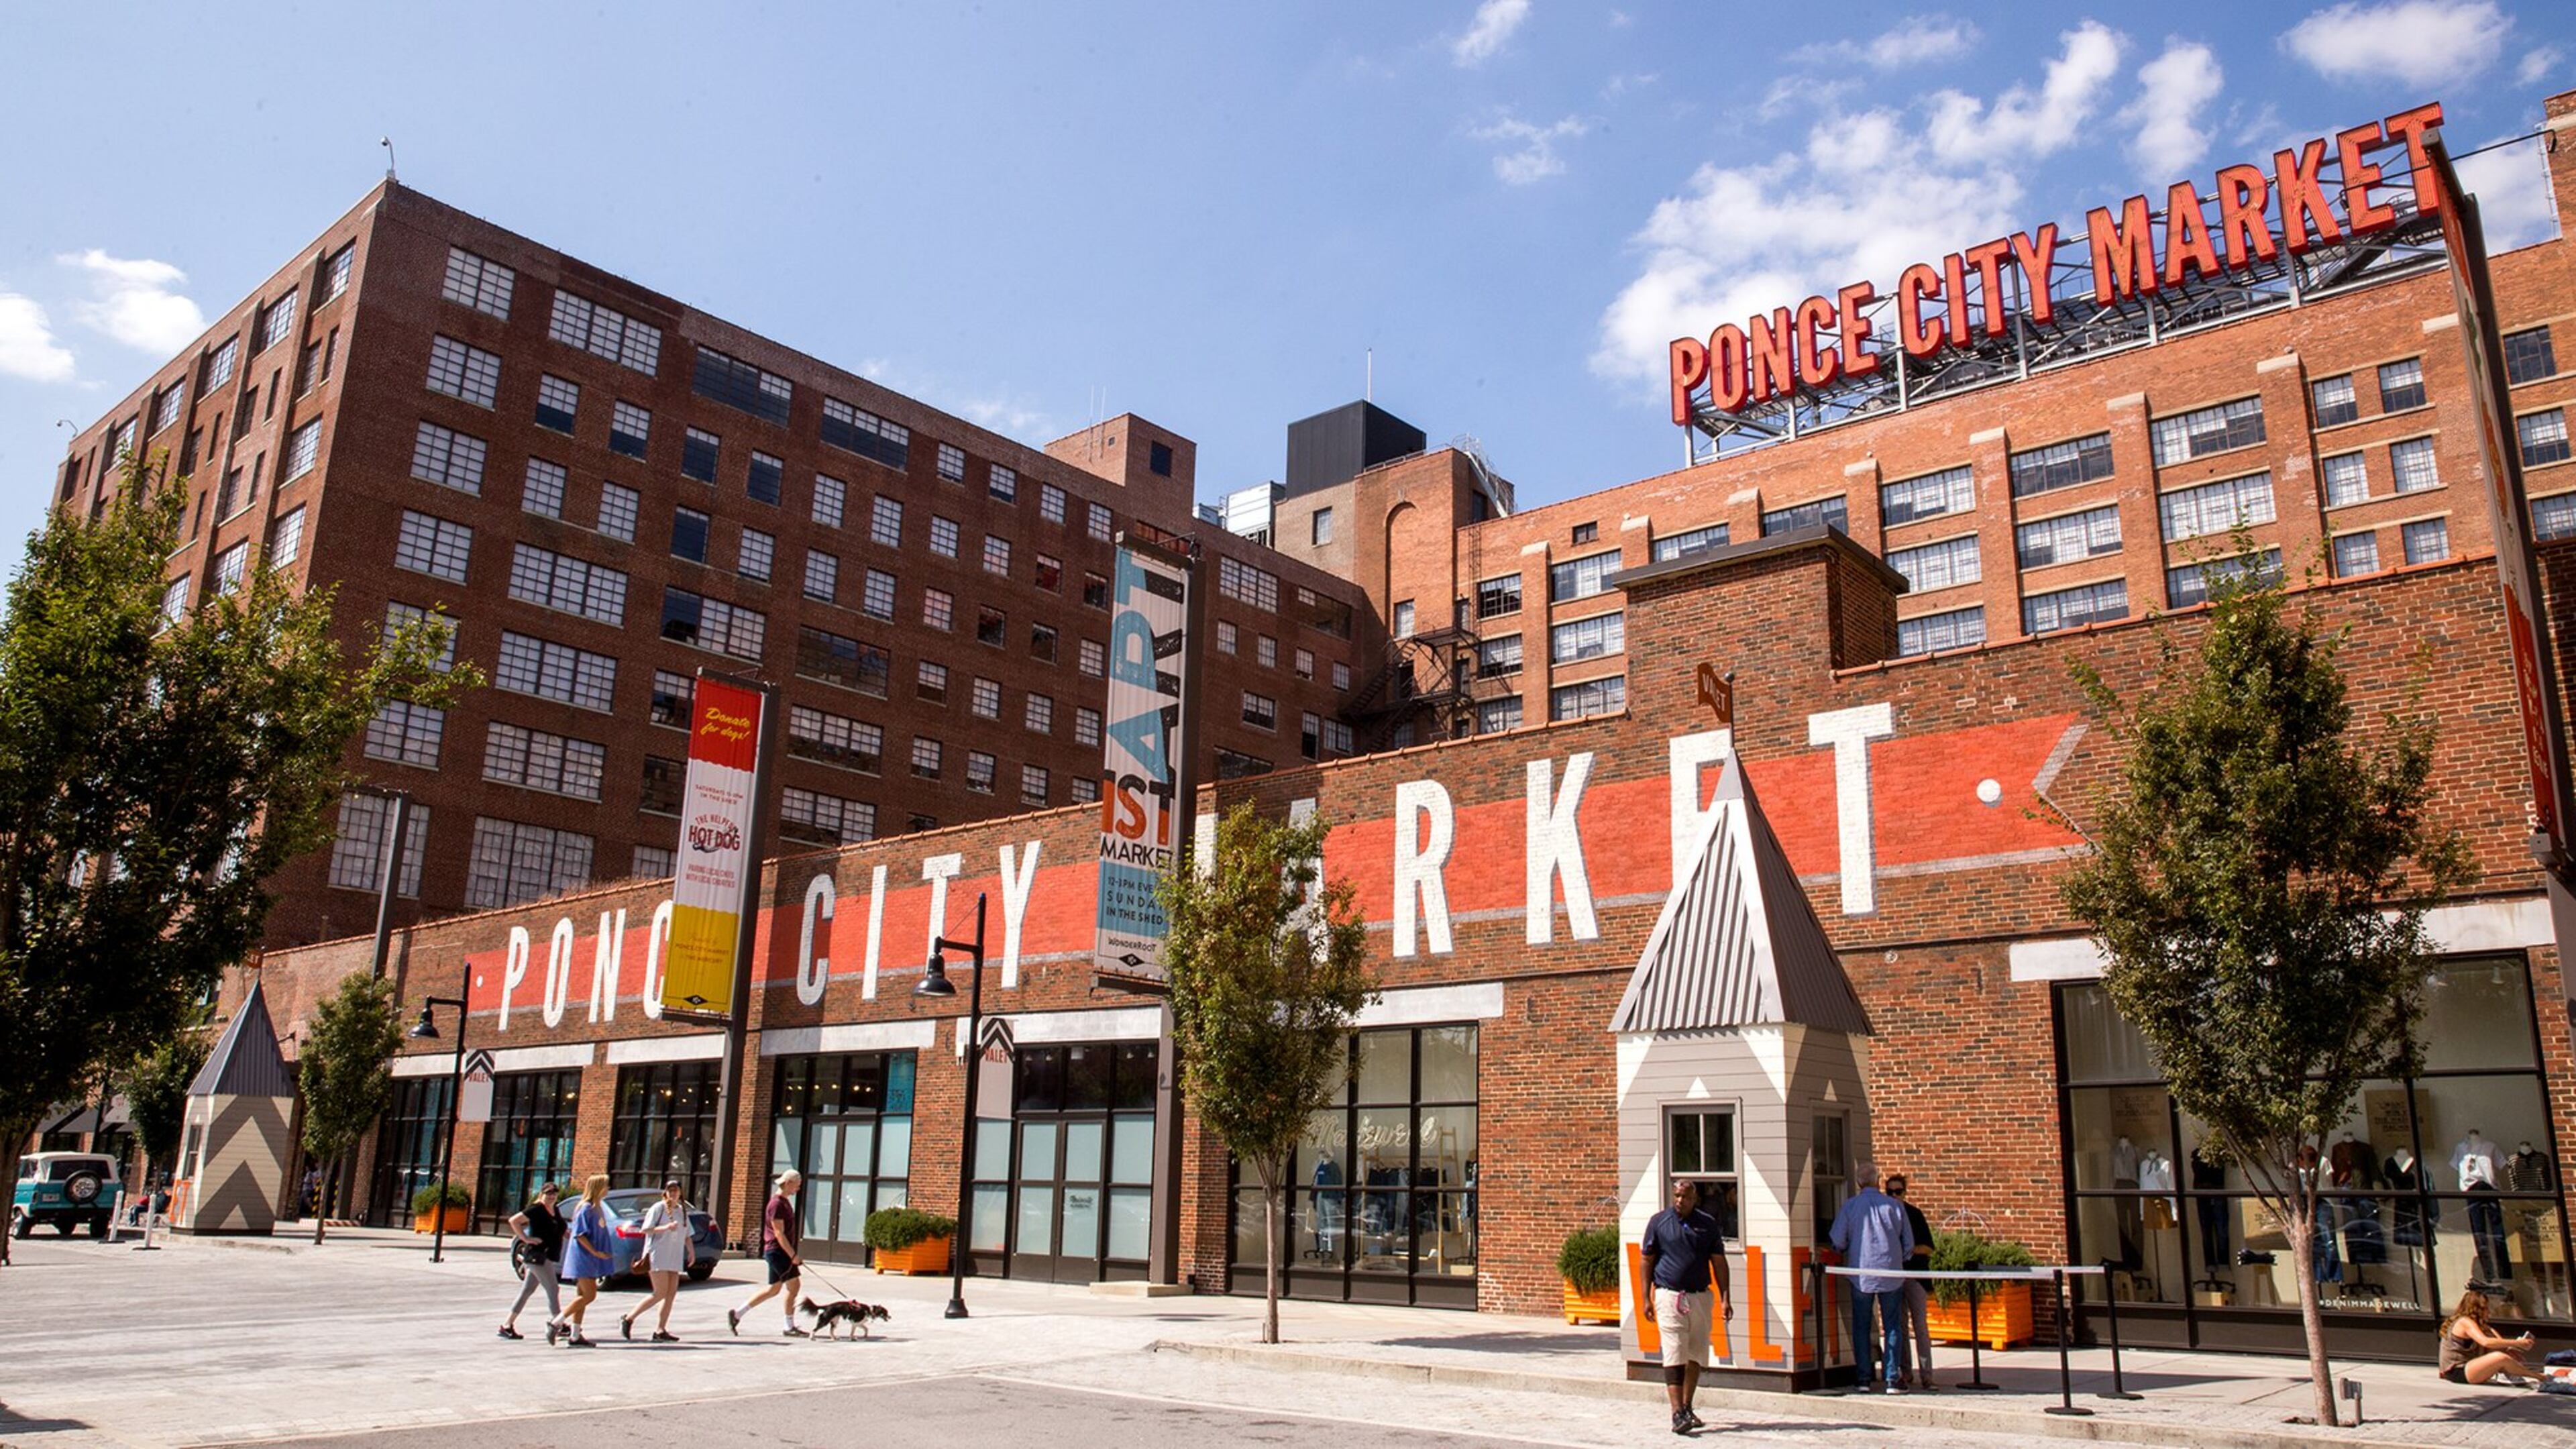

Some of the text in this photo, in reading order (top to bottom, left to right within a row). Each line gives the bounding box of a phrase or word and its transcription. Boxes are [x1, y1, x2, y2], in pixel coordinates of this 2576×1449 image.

[1670, 101, 2443, 426] PONCE CITY MARKET
[706, 707, 751, 728] Donate
[700, 722, 720, 735] for
[695, 814, 708, 825] THE
[688, 824, 741, 851] HOT DOG
[1138, 882, 1153, 894] EVE
[1106, 906, 1164, 926] IN THE SHED
[497, 899, 674, 1030] PONC
[796, 840, 1042, 1006] CITY
[985, 1048, 1009, 1063] VALET
[468, 1073, 490, 1083] VALET
